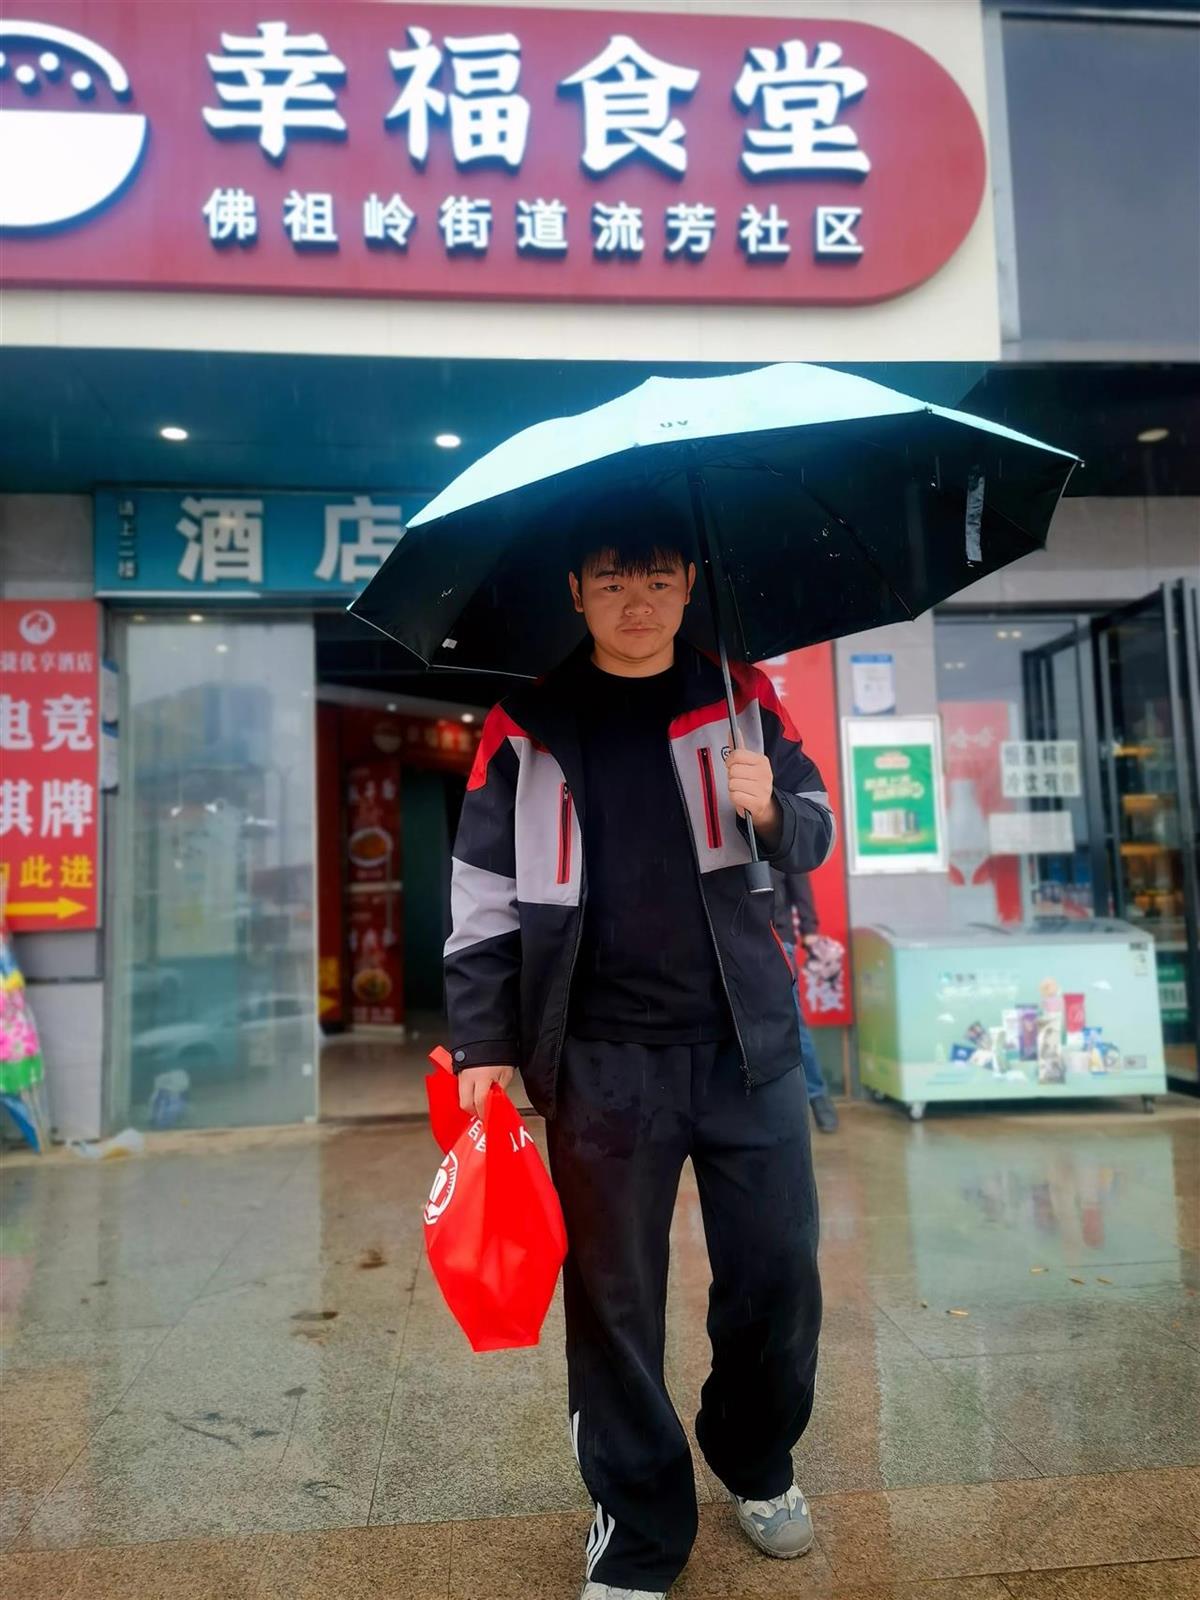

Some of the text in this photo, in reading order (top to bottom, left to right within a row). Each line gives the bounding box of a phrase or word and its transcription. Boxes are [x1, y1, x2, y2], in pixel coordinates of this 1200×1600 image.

[202, 21, 870, 176] 幸福食堂
[203, 188, 863, 256] 佛祖岭街道流芳社区
[176, 496, 402, 584] 酒店
